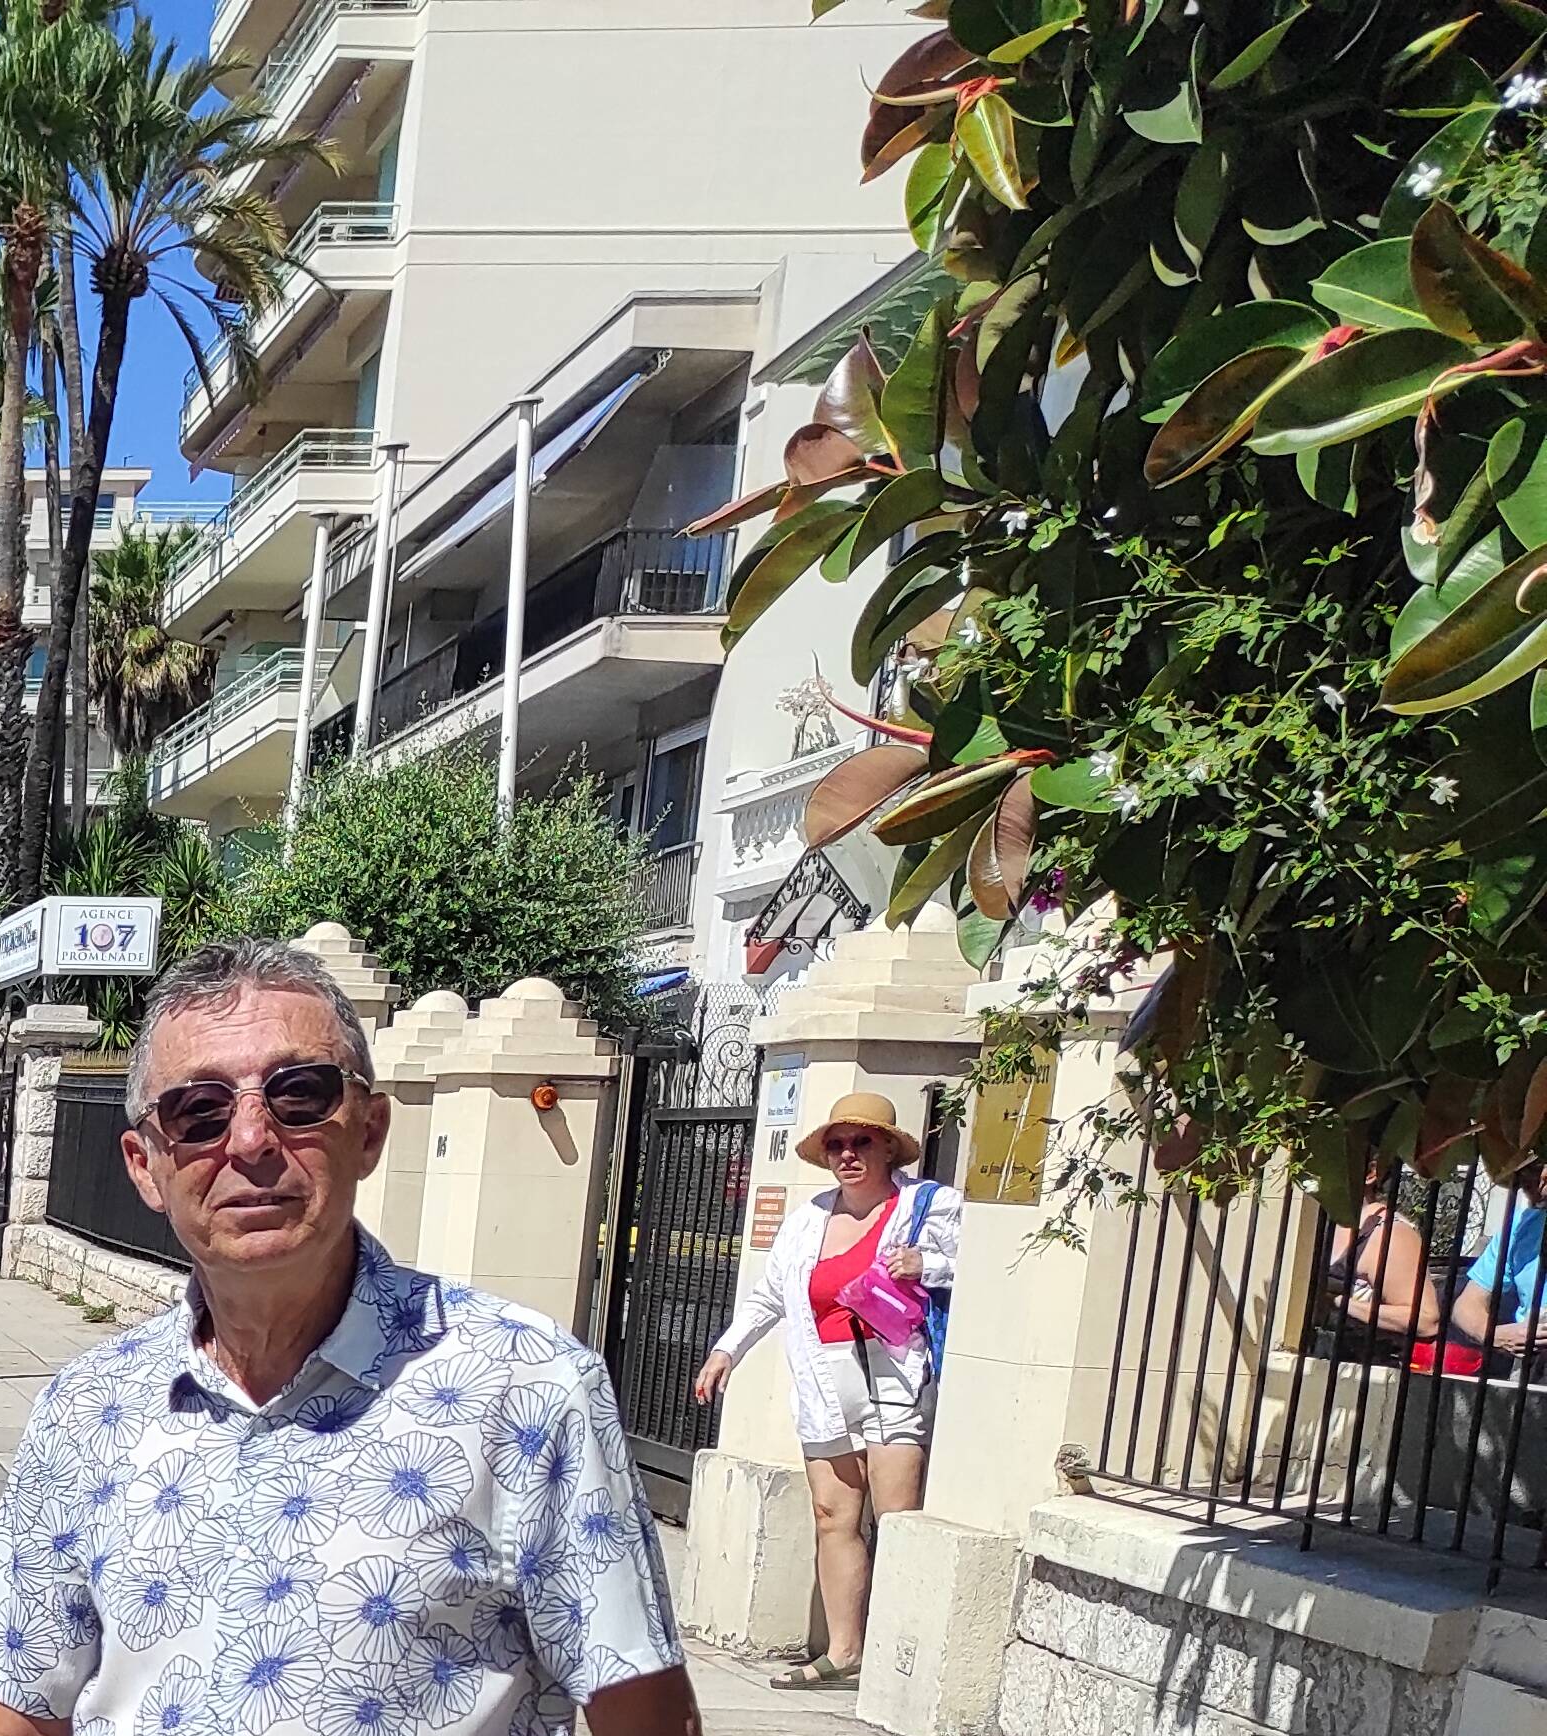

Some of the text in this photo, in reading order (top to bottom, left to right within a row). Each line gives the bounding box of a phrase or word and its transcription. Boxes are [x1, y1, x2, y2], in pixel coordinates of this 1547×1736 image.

[80, 910, 134, 919] AGENCE
[74, 924, 137, 951] 107
[62, 952, 145, 962] PROMENADE
[768, 1129, 789, 1162] 105
